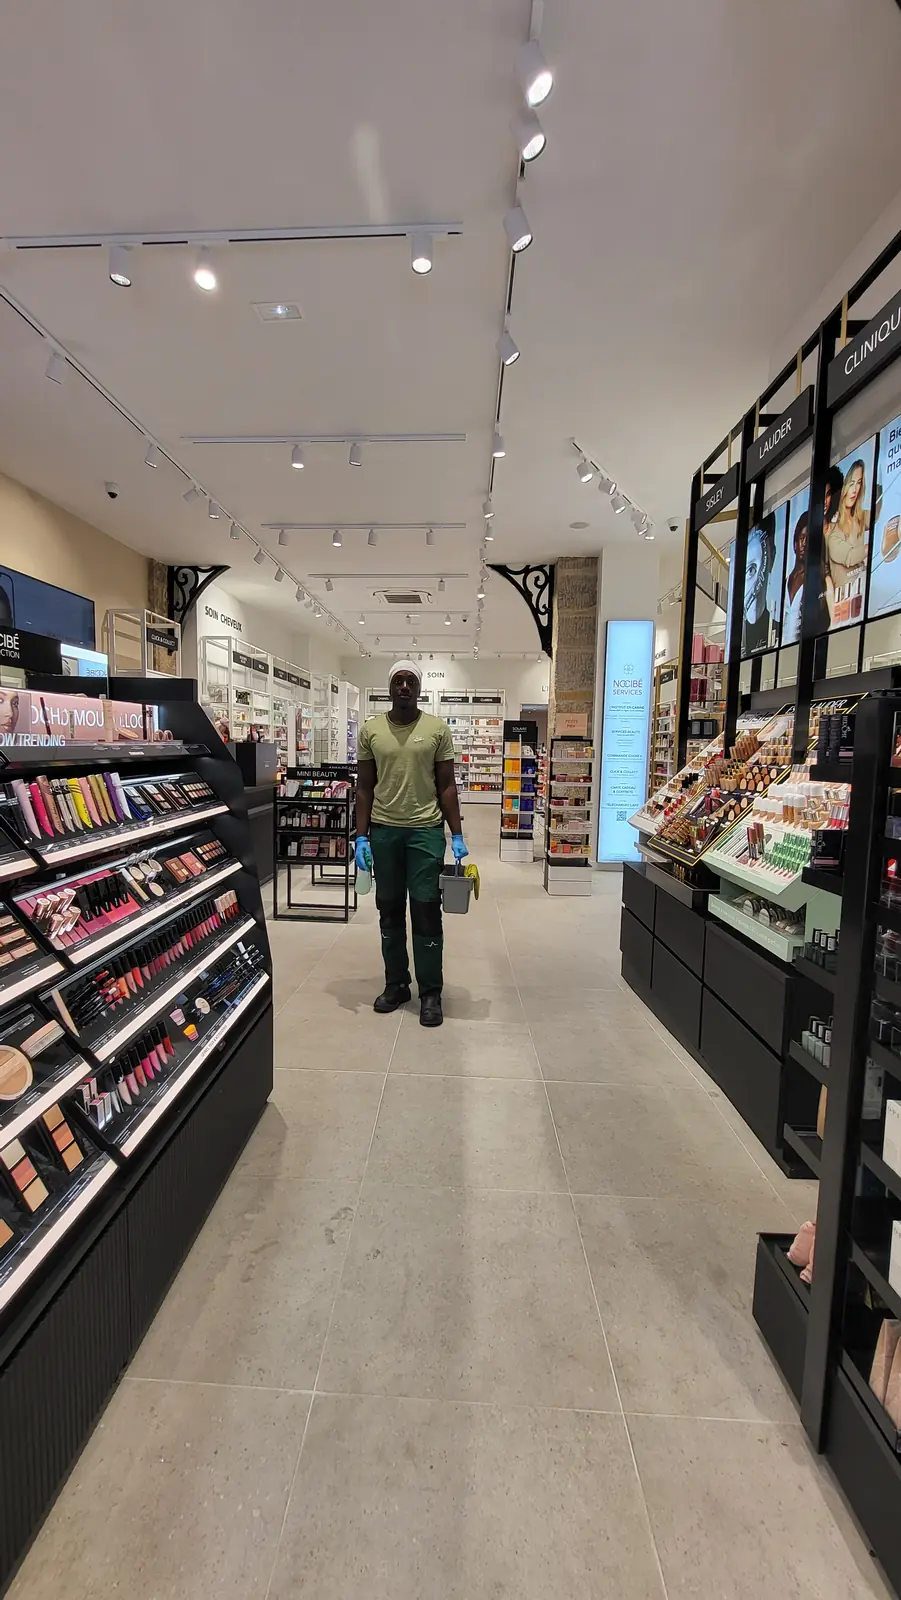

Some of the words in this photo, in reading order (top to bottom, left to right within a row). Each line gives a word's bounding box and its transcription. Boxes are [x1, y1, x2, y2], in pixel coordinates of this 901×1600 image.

[759, 417, 792, 459] LAUDER
[888, 442, 901, 459] qu
[705, 486, 724, 512] SISLEY
[204, 605, 219, 621] SOIN
[220, 613, 243, 632] CHEVEUX
[18, 734, 66, 747] TRENDING
[296, 770, 312, 778] MINI
[312, 770, 338, 778] BEAUTY
